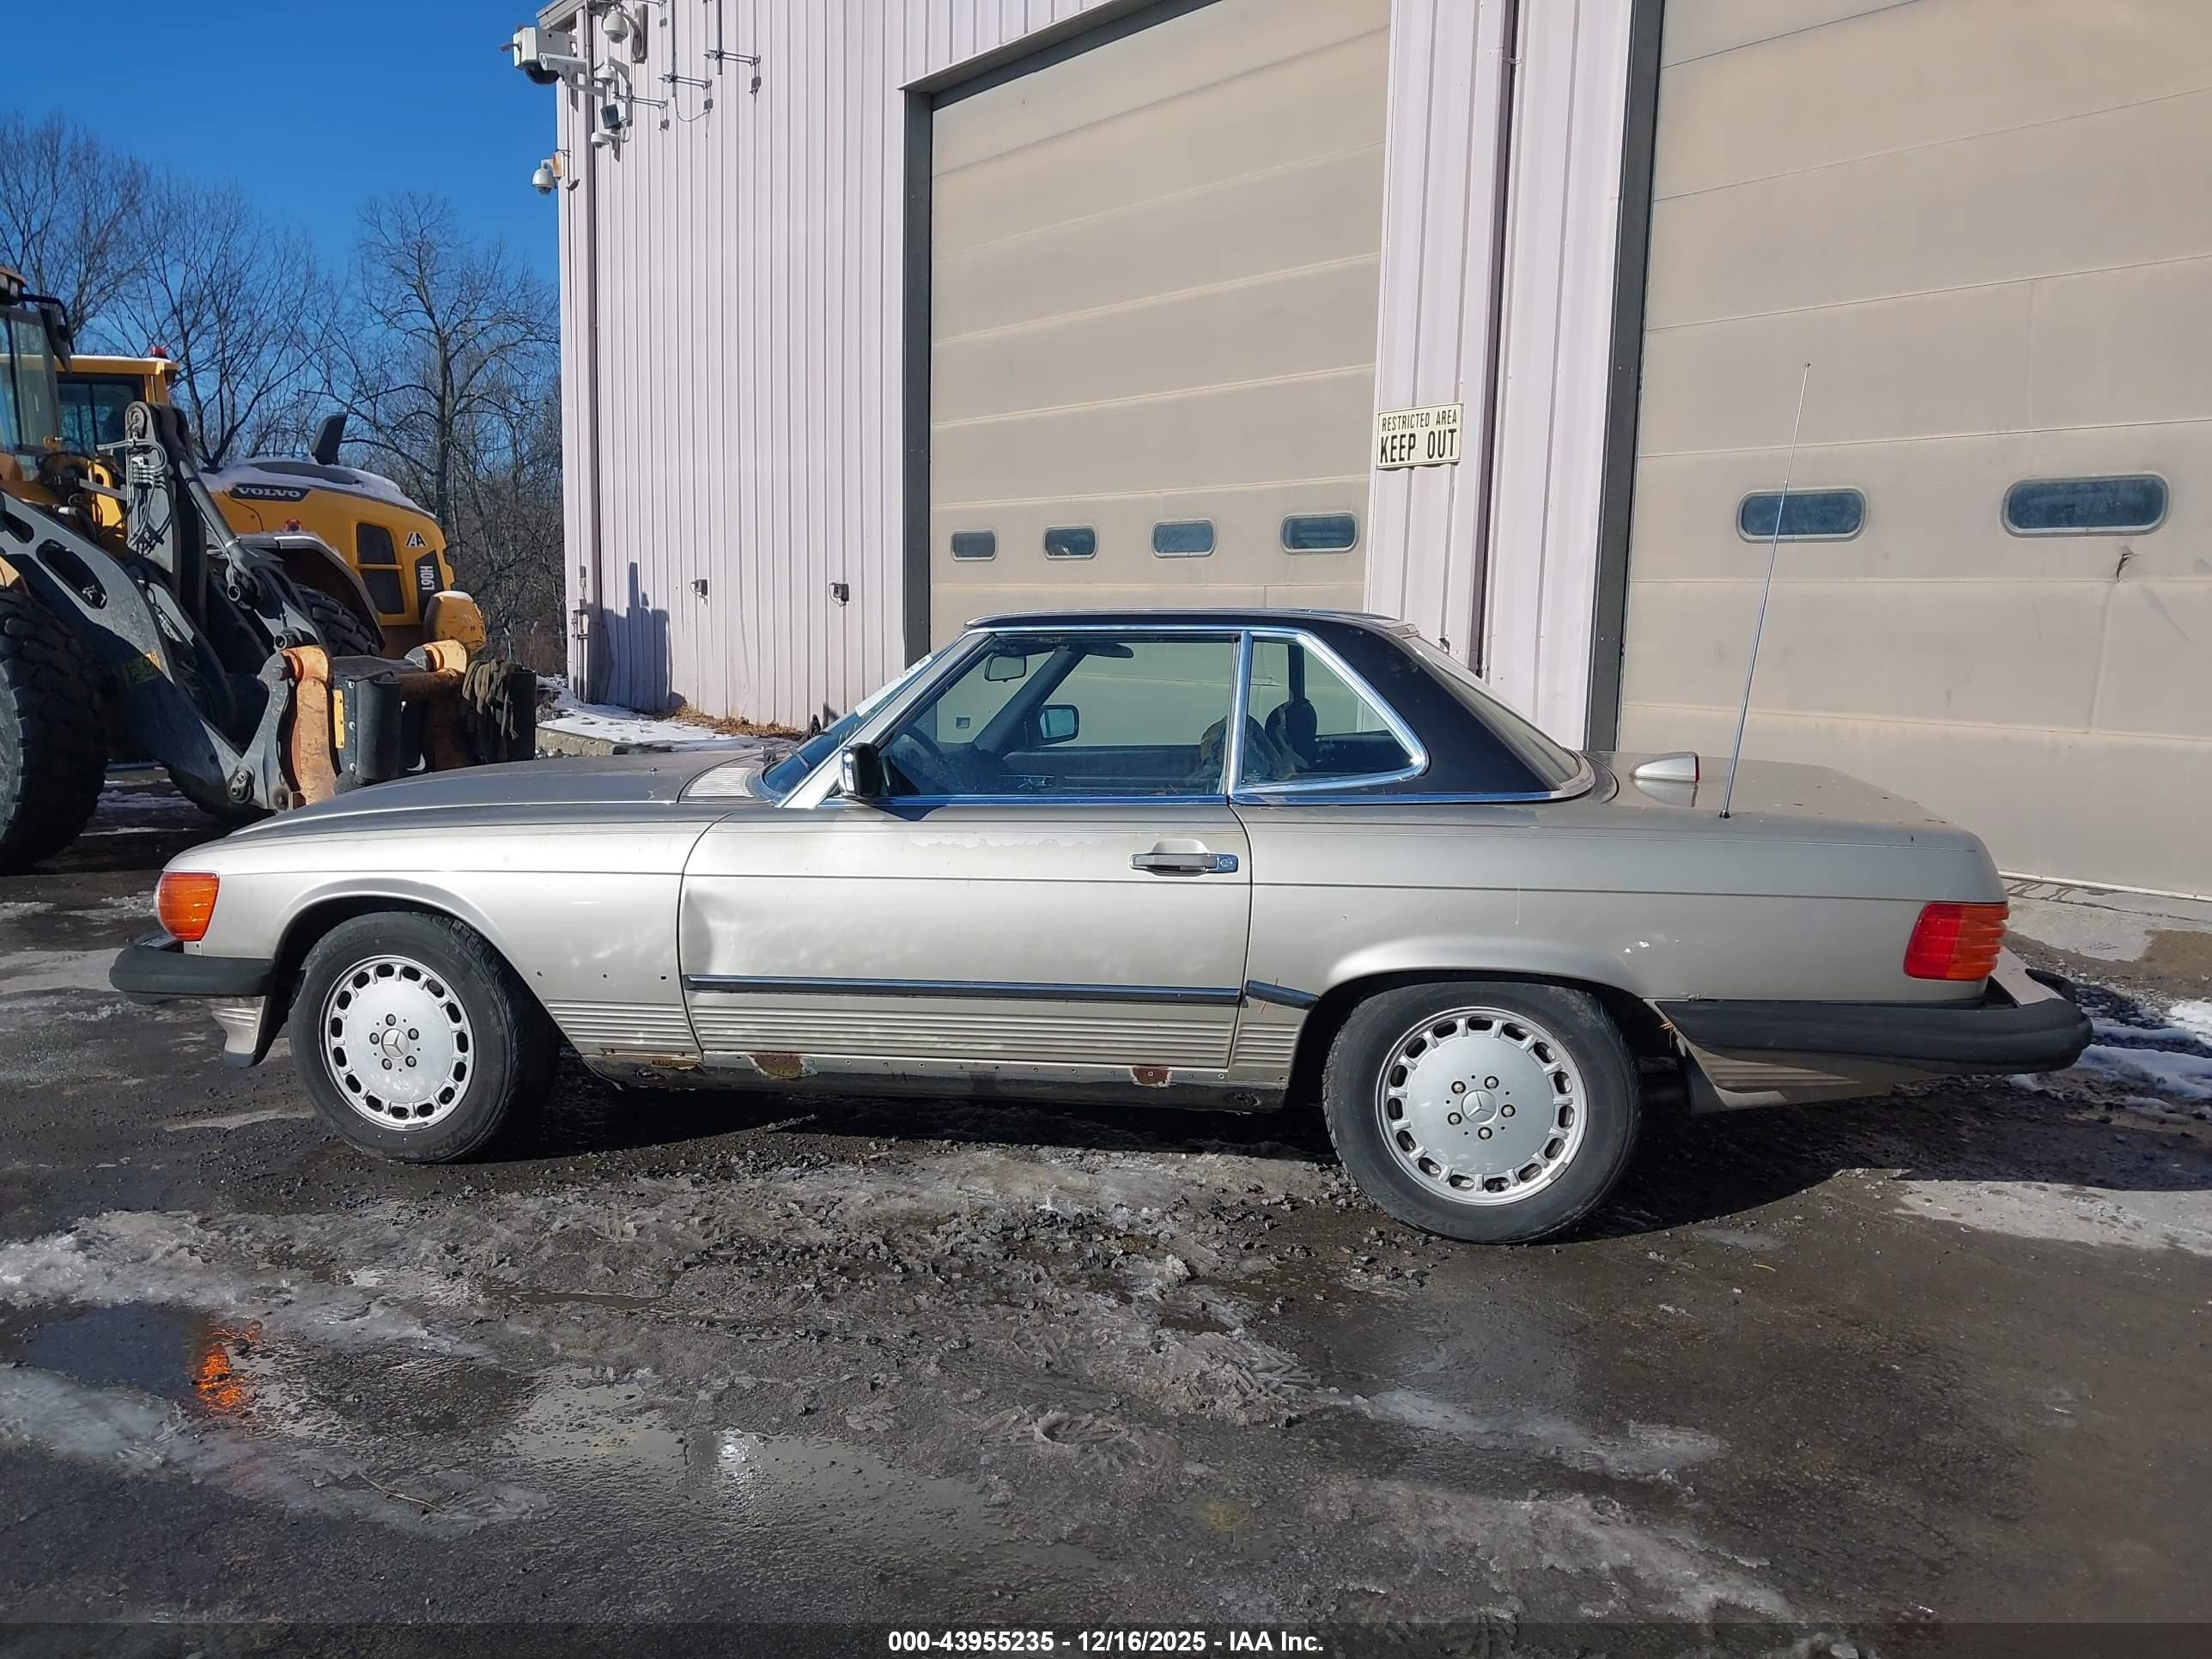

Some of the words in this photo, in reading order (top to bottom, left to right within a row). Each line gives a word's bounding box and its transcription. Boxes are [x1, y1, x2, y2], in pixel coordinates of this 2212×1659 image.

[1382, 412, 1431, 432] RESTRICTED
[1436, 409, 1457, 426] AREA
[1380, 432, 1417, 464] KEEP
[1426, 428, 1457, 459] OUT
[237, 487, 301, 498] VOLVO
[419, 565, 435, 591] L90H
